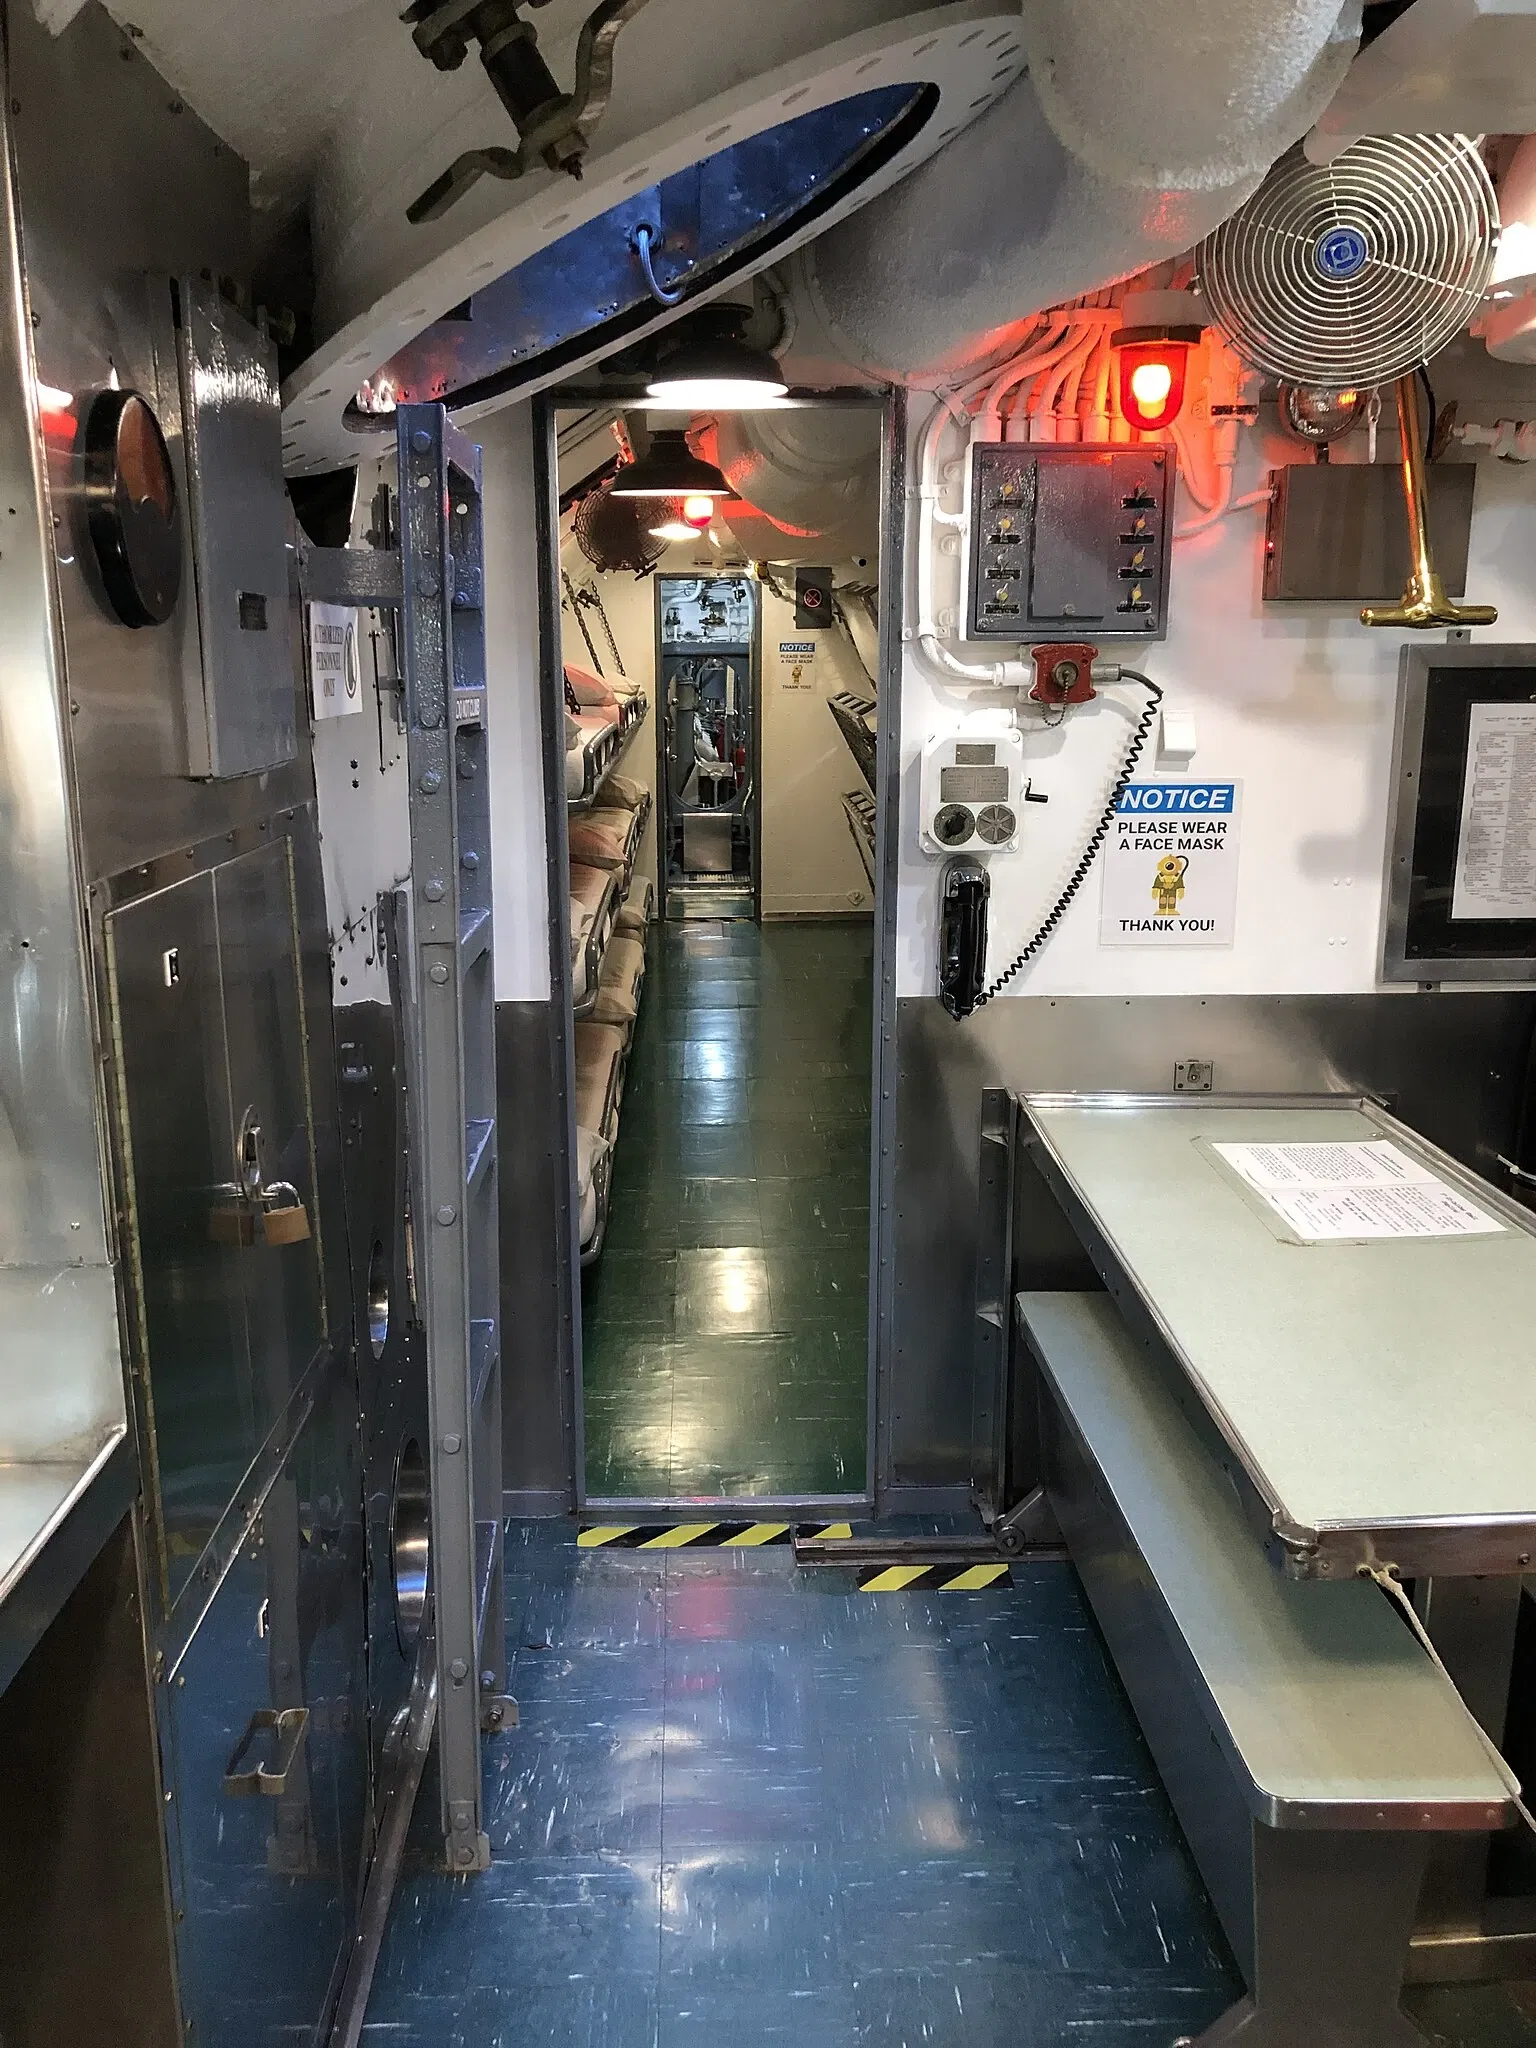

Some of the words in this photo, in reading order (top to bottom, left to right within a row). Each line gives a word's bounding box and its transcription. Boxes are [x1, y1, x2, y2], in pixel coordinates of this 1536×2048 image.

[314, 624, 343, 645] AUTHORIZED
[316, 651, 341, 671] PERSONNEL
[323, 678, 335, 697] ONLY
[1119, 788, 1230, 809] NOTICE
[1118, 821, 1178, 834] PLEASE
[1182, 821, 1228, 834] WEAR
[1119, 838, 1130, 850] A
[1134, 838, 1173, 850] FACE
[1177, 838, 1224, 850] MASK
[1120, 919, 1174, 932] THANK
[1179, 919, 1215, 932] YOU!
